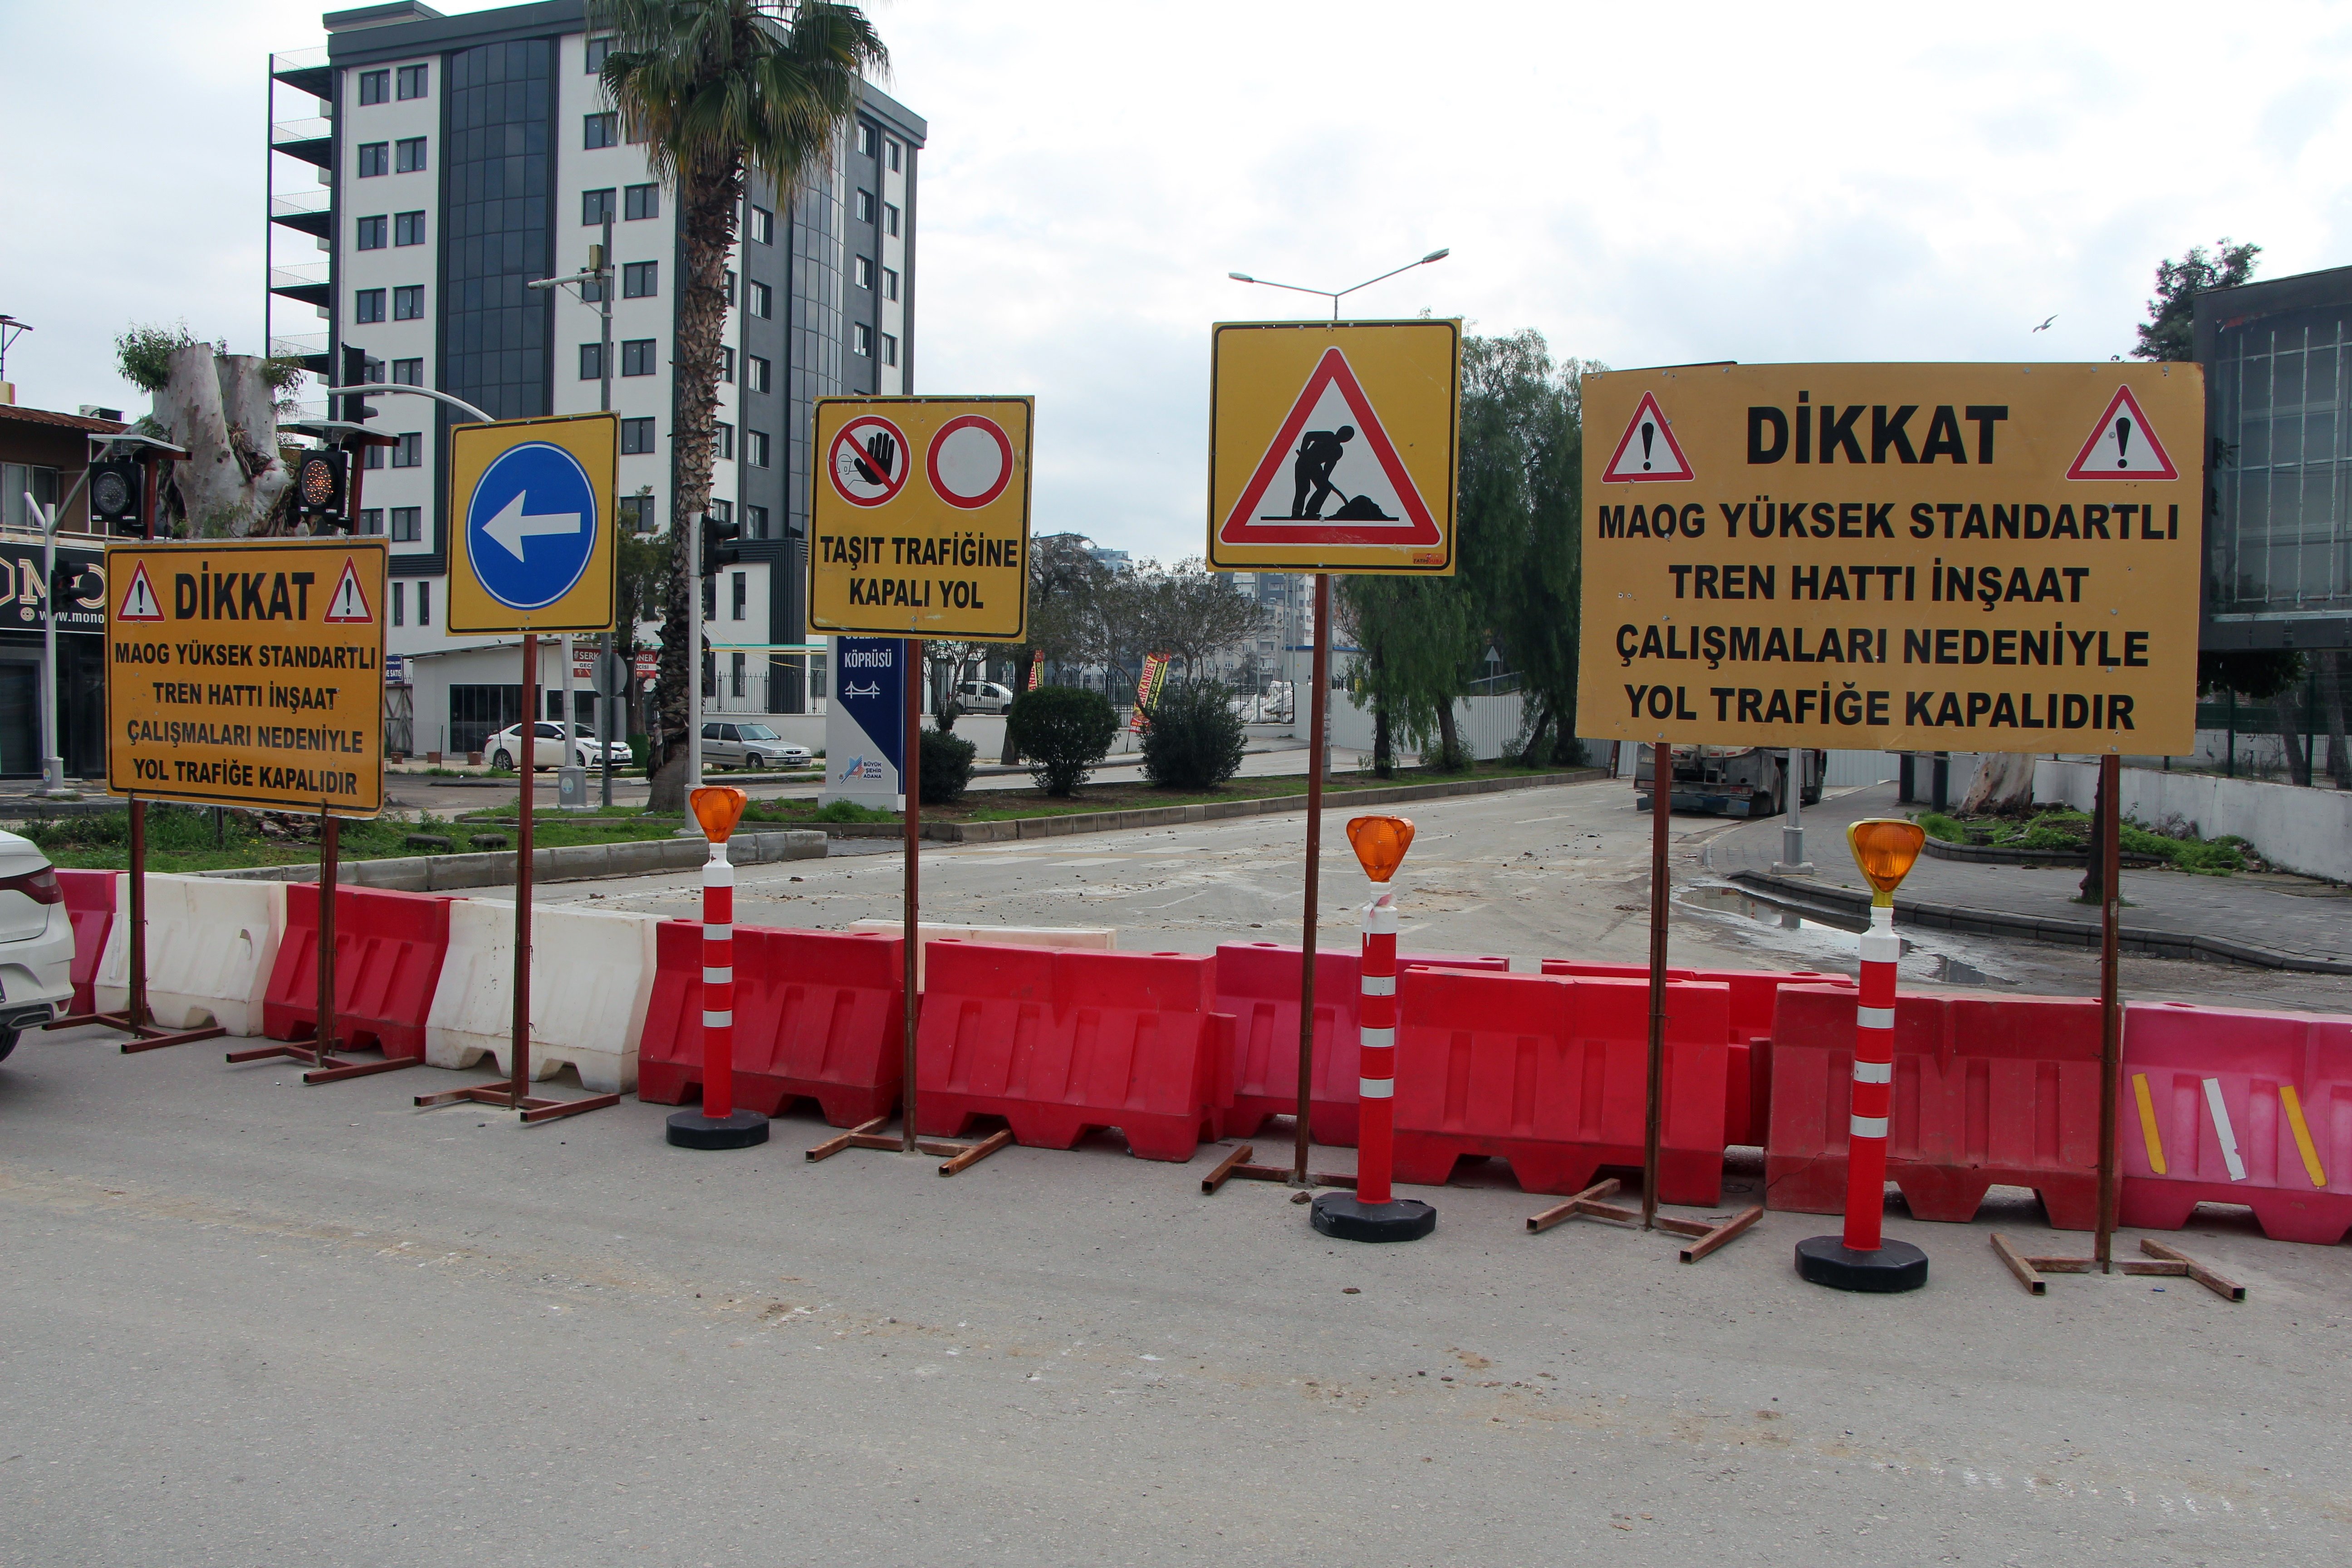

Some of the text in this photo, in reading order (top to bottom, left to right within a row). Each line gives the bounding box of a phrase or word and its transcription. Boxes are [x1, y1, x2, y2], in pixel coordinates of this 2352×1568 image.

[1747, 390, 2009, 464] DİKKAT
[1599, 495, 2178, 540] MAOG YÜKSEK STANDARTLI
[820, 531, 1018, 571] TAŞIT TRAFİĞİNE
[175, 561, 315, 621] DİKKAT
[849, 578, 984, 609] KAPALI YOL
[1669, 557, 2090, 612] TREN HATTI İNŞAAT
[115, 639, 375, 669] MAOG YÜKSEK STANDARTLI
[844, 649, 892, 668] KÖPRÜSÜ
[1616, 621, 2149, 670] ÇALIŞMALARI NEDENİYLE
[390, 669, 402, 679] SATIŞ
[152, 681, 338, 715] TREN HATTI İNŞAAT
[1624, 681, 2135, 730] YOL TRAFİĞE KAPALIDIR
[127, 720, 363, 753] ÇALIŞMALARI NEDENİYLE
[132, 758, 357, 795] YOL TRAFİĞE KAPALIDIR
